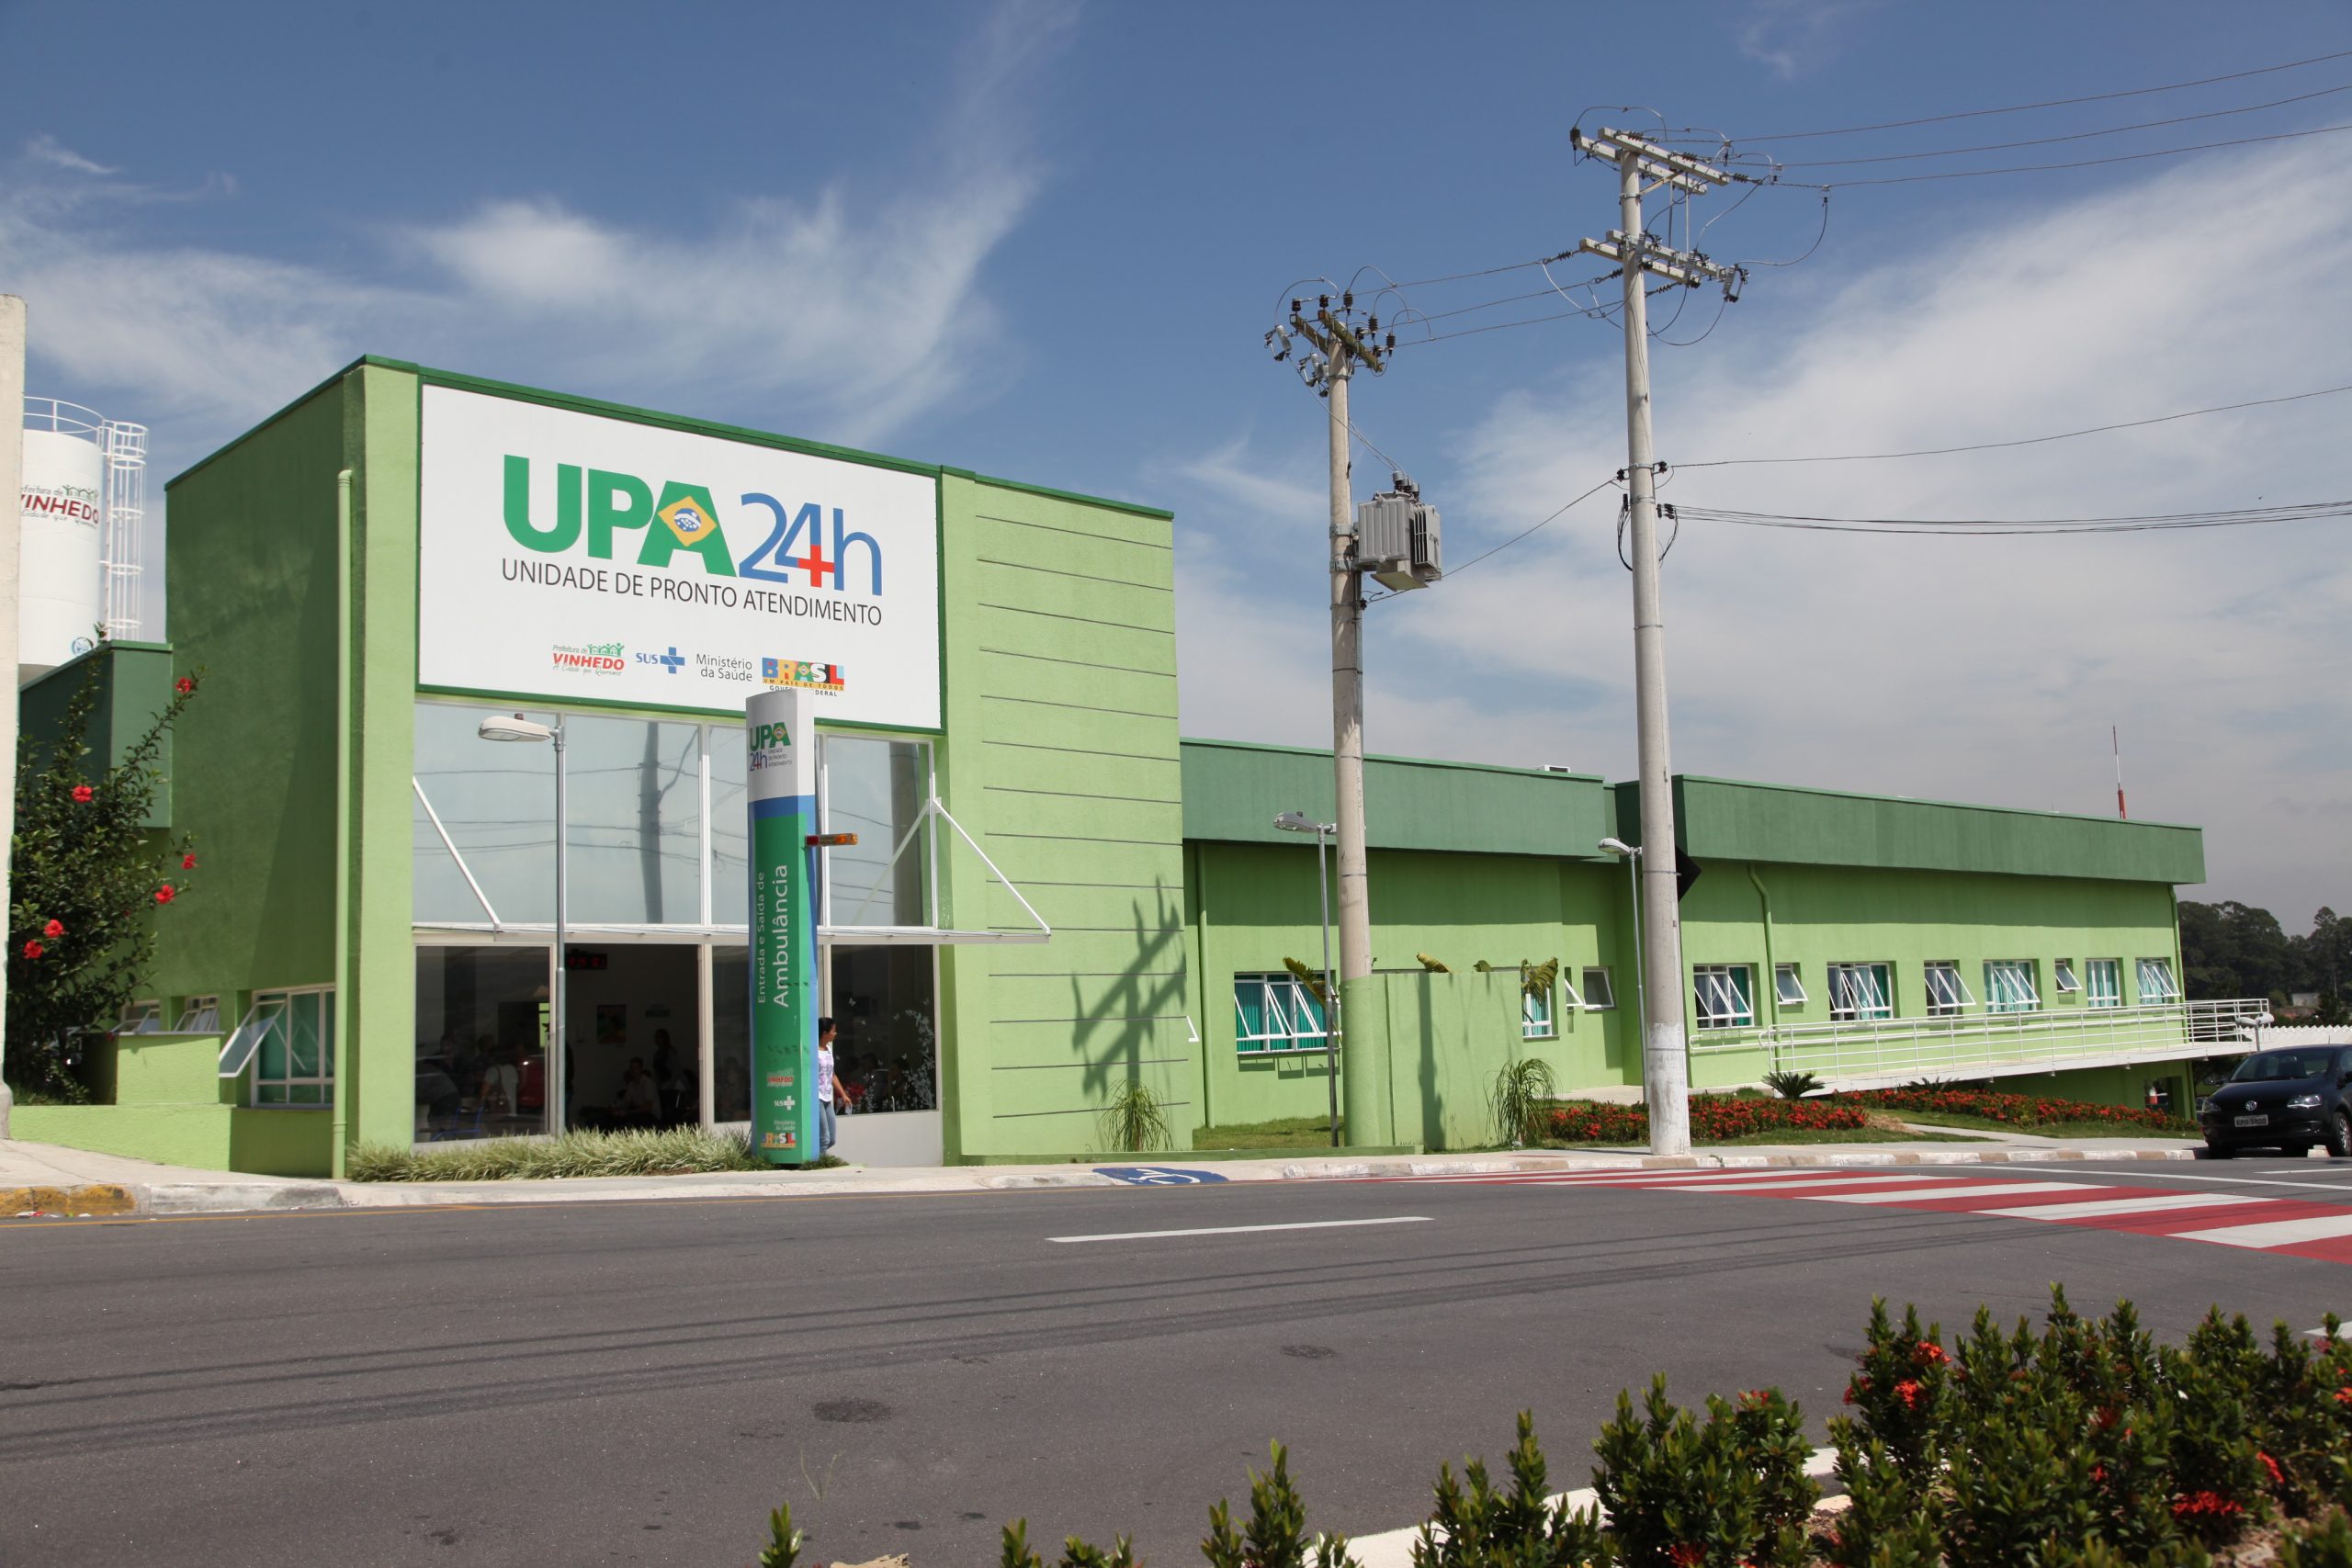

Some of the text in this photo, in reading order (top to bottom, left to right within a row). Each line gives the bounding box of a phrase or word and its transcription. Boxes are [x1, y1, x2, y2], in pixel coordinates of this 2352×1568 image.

[503, 454, 883, 596] UPA 24h
[502, 558, 882, 626] UNIDADE DE PRONTO ATENDIMENTO
[552, 644, 580, 654] Prefeitura
[636, 652, 659, 665] SUS
[553, 652, 625, 671] VINHEDO
[695, 653, 752, 671] Ministério
[700, 667, 752, 682] da Saúde
[815, 689, 837, 697] DERAL
[749, 722, 791, 751] UPA
[749, 750, 768, 772] 24h
[756, 872, 766, 1003] Entrada e Saída de
[772, 864, 788, 1008] Ambulância
